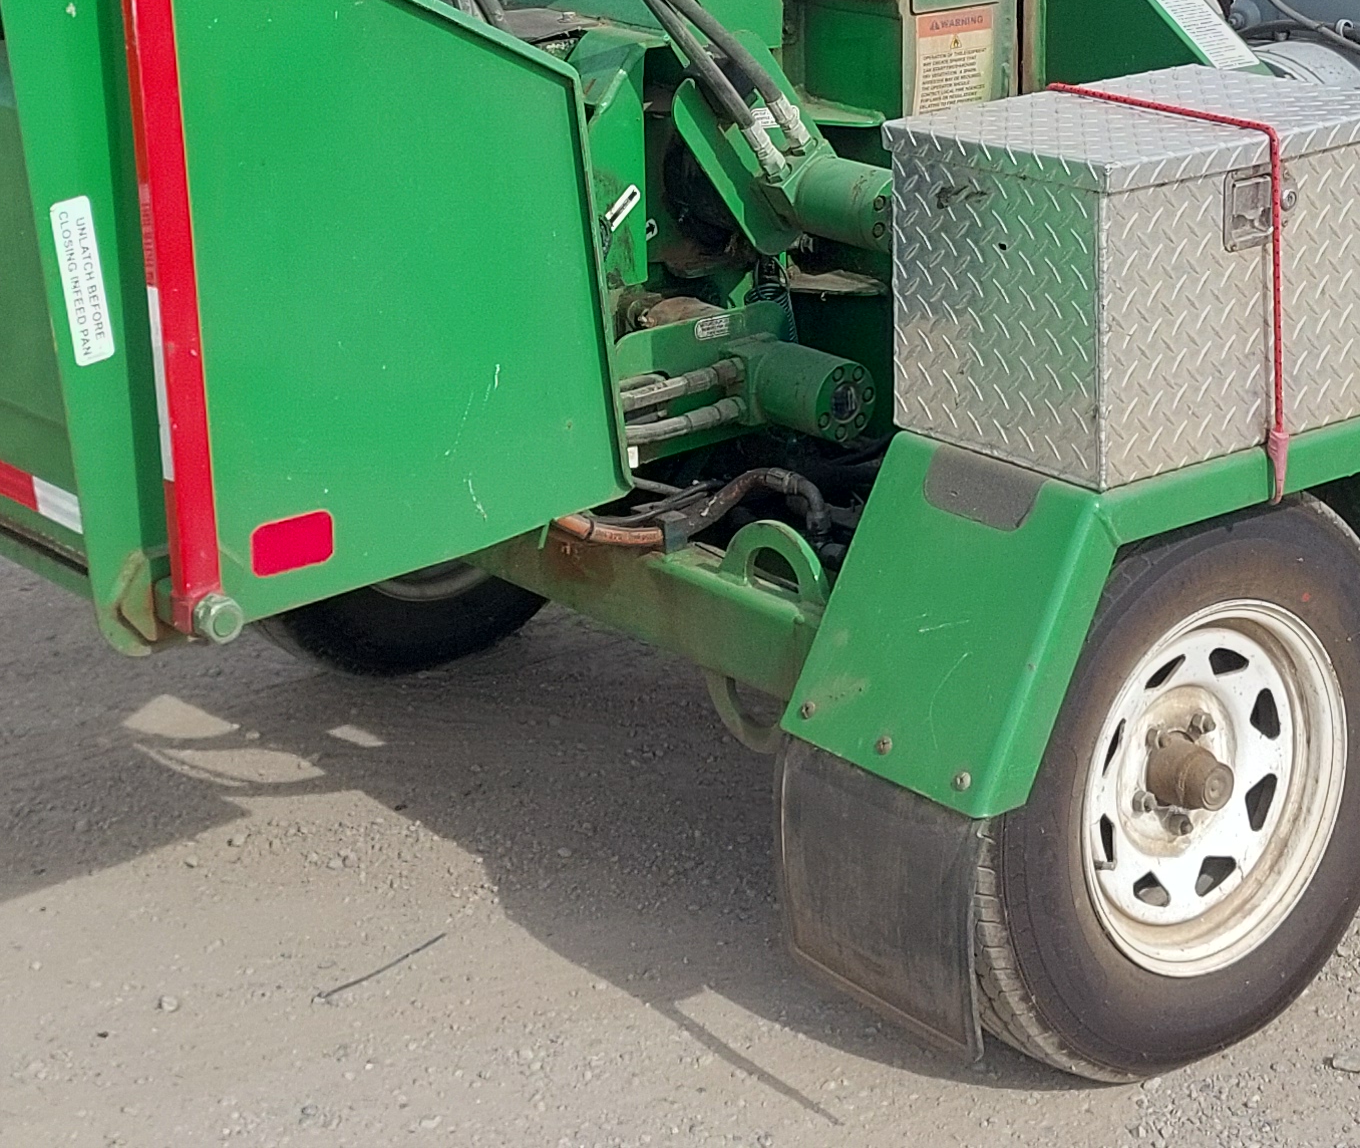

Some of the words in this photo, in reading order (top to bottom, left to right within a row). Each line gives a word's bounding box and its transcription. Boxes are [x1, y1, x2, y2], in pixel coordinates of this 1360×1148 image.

[940, 15, 983, 28] WARNING
[58, 210, 78, 272] CLOSING
[70, 275, 87, 325] INFEED
[80, 328, 92, 357] PAN
[75, 216, 95, 281] UNLATCH
[87, 284, 106, 340] BEFORE
